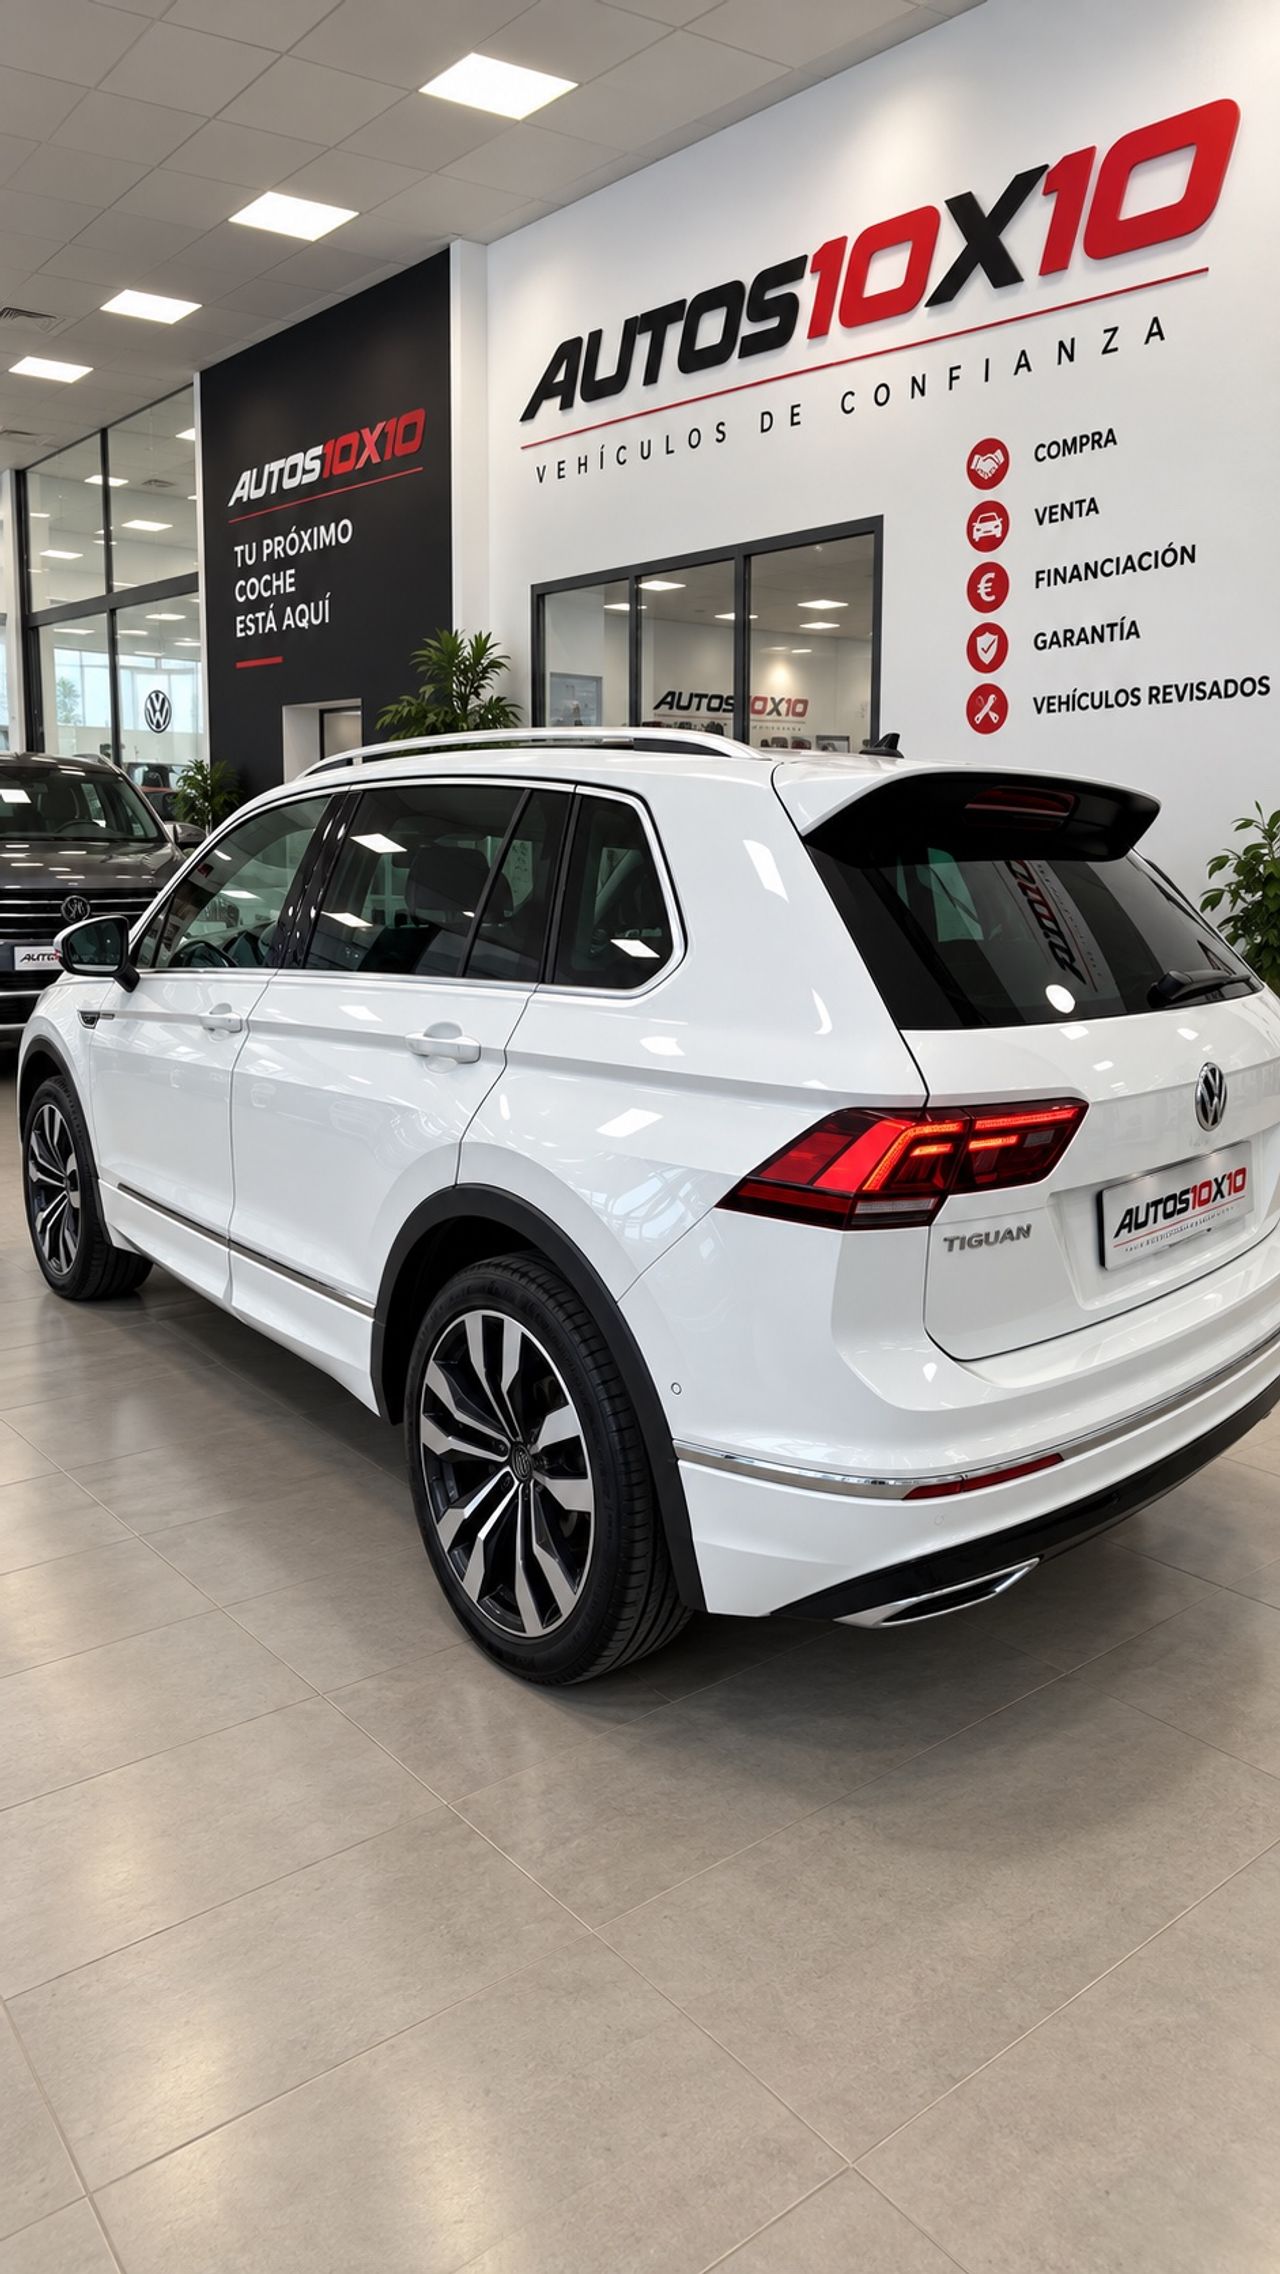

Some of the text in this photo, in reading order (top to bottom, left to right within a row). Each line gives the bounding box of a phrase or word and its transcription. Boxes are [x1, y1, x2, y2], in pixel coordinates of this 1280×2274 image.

[519, 98, 1240, 422] AUTOS10X10
[536, 315, 1166, 483] VEHÍCULOS DE CONFIANZA
[228, 408, 426, 507] AUTOS10X10
[1034, 428, 1118, 463] COMPRA
[1034, 497, 1100, 526] VENTA
[234, 518, 353, 567] TU PRÓXIMO
[235, 569, 296, 602] COCHE
[1035, 542, 1197, 589] FINANCIACIÓN
[236, 592, 331, 638] ESTÁ AQUÍ
[1034, 616, 1141, 651] GARANTÍA
[653, 690, 809, 718] AUTOS0X10
[1033, 675, 1271, 715] VEHÍCULOS REVISADOS
[1113, 1167, 1247, 1239] AUTOS10X10
[943, 1223, 1032, 1252] TIGUAN
